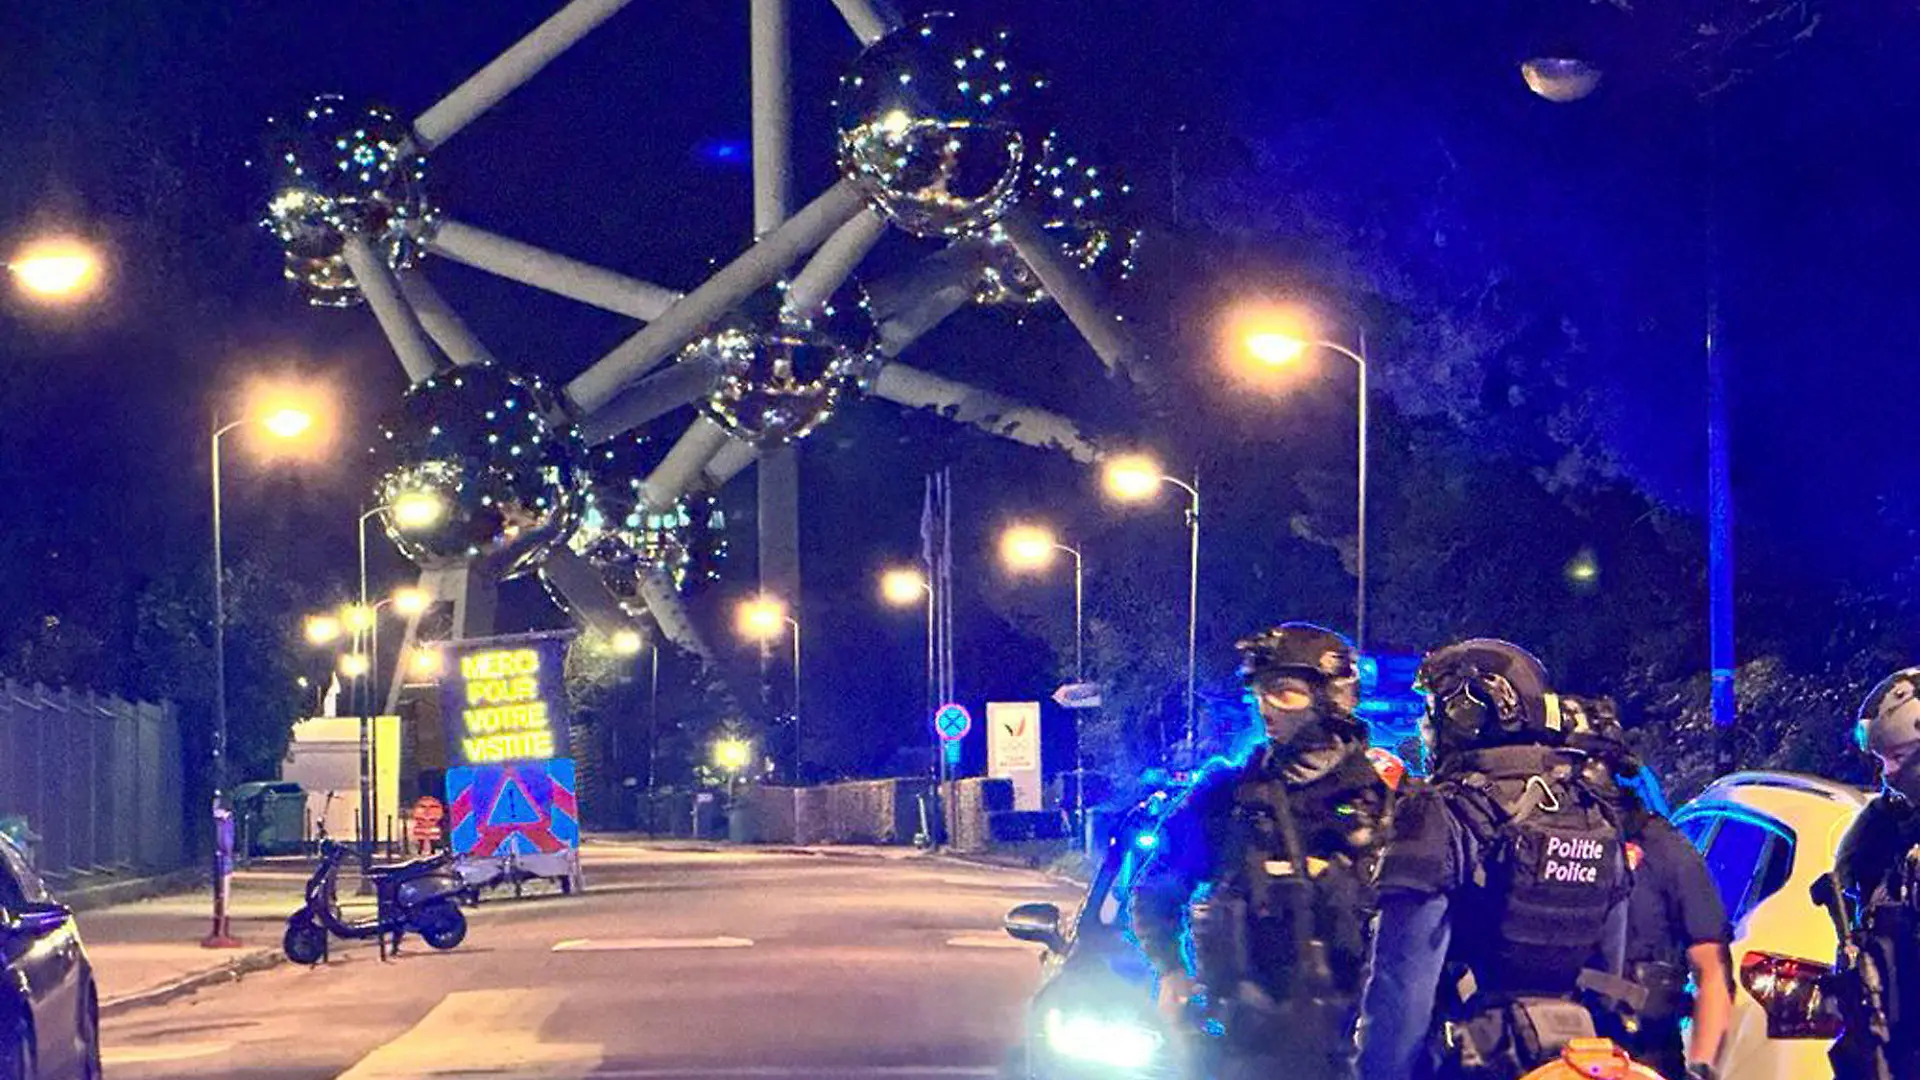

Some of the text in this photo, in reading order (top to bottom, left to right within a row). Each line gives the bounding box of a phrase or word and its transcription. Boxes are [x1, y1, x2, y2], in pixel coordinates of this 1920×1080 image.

[466, 675, 539, 705] POUR
[462, 702, 549, 733] VOTRE
[1547, 837, 1604, 859] Politie
[1545, 861, 1597, 882] Police
